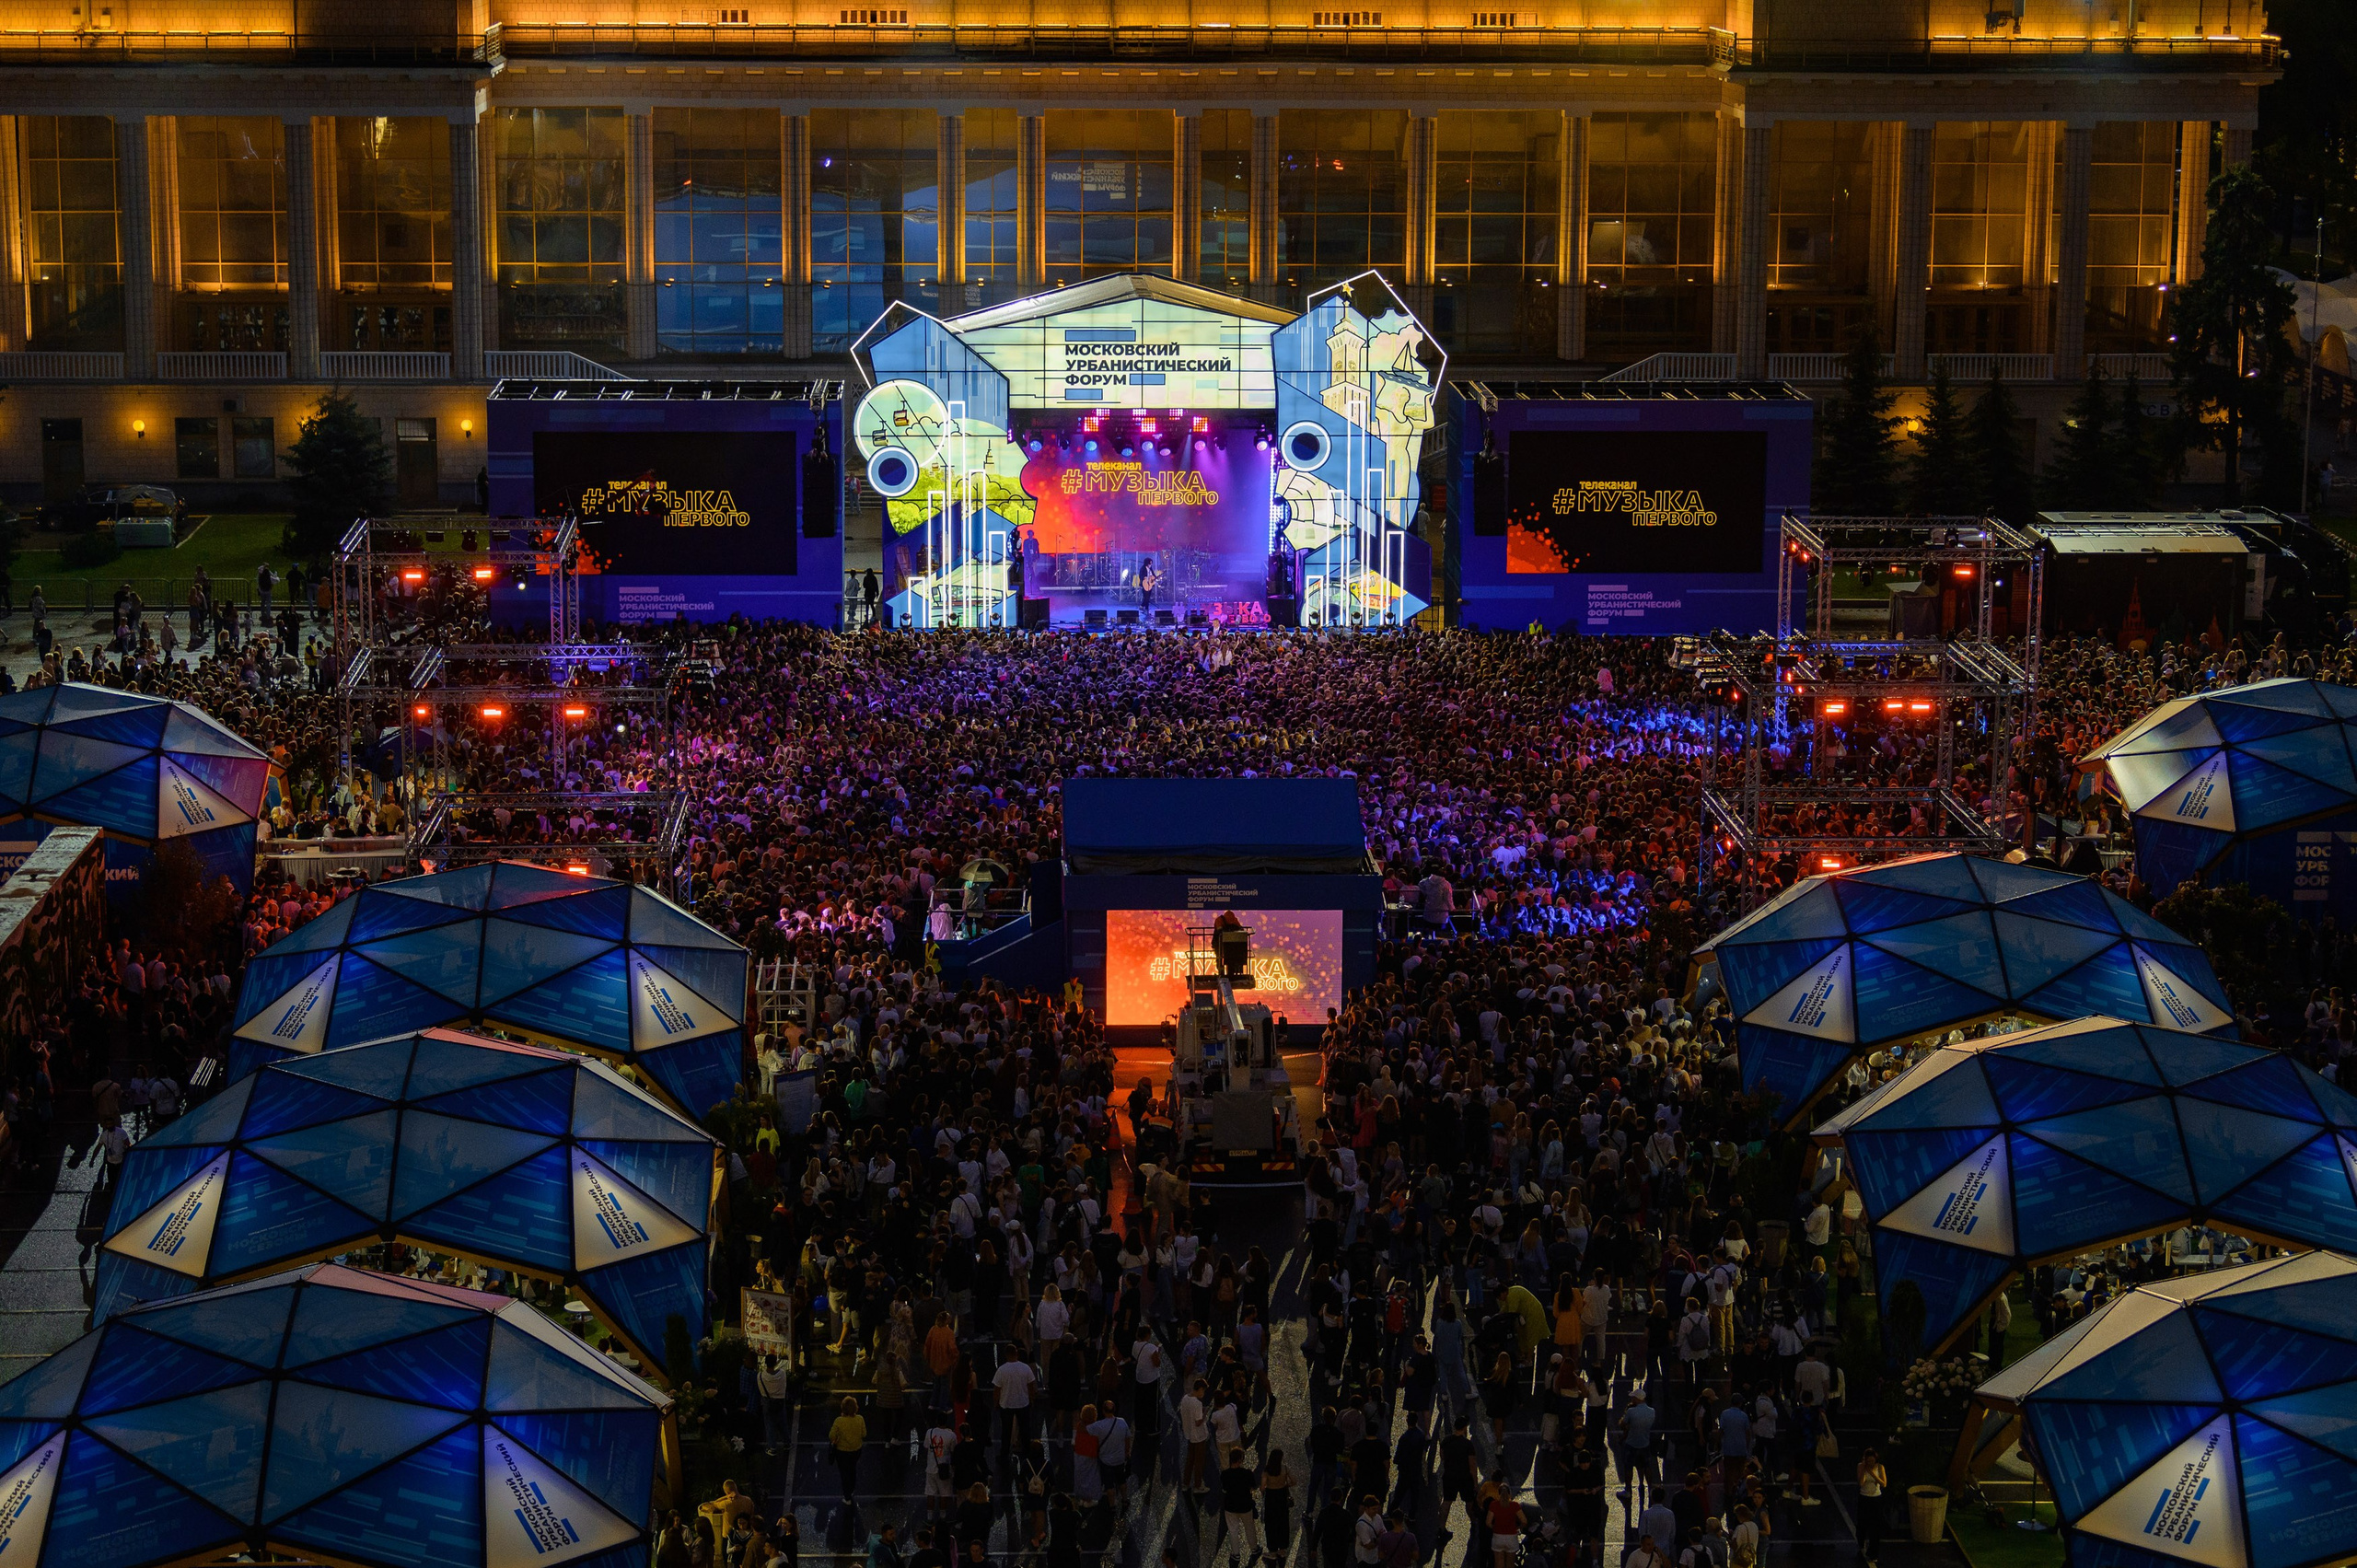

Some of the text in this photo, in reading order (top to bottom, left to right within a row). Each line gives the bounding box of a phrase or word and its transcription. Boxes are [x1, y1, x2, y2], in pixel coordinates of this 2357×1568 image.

[1065, 343, 1179, 356] МОСКОВСКИЙ
[1066, 357, 1231, 372] УРБАНИСТИЧЕСКИЙ
[1065, 374, 1127, 386] ФОРУМ
[1062, 469, 1206, 494] #МУЗЫКА
[1086, 462, 1142, 470] телеканал
[1138, 492, 1219, 505] ПЕРВОГО
[1552, 488, 1704, 515] #МУЗЫКА
[1579, 481, 1637, 491] телеканал
[1632, 511, 1717, 527] ПЕРВОГО
[619, 594, 685, 603] МОСКОВСКИЙ
[619, 611, 656, 620] ФОРУМ
[620, 602, 714, 611] УРБАНИСТИЧЕСКИЙ
[1587, 592, 1654, 600] МОСКОВСКИЙ
[1588, 600, 1682, 610] УРБАНИСТИЧЕСКИЙ
[168, 766, 205, 824] УРБАНИСТИЧЕСКИЙ
[173, 784, 200, 825] МОСКОВСКИЙ
[2182, 777, 2206, 817] МОСКОВСКИЙ
[2188, 761, 2220, 818] УРБАНИСТИЧЕСКИЙ
[2194, 797, 2208, 819] ФОРУМ
[195, 800, 210, 822] ФОРУМ
[282, 967, 332, 1038] УРБАНИСТИЧЕСКИЙ
[637, 962, 684, 1031] УРБАНИСТИЧЕСКИЙ
[644, 984, 679, 1033] МОСКОВСКИЙ
[1794, 975, 1825, 1024] МОСКОВСКИЙ
[1801, 956, 1843, 1025] УРБАНИСТИЧЕСКИЙ
[2140, 956, 2192, 1025] УРБАНИСТИЧЕСКИЙ
[2151, 978, 2189, 1027] МОСКОВСКИЙ
[277, 987, 313, 1037] МОСКОВСКИЙ
[287, 1012, 308, 1039] ФОРУМ
[670, 1004, 690, 1030] ФОРУМ
[1807, 1000, 1826, 1027] ФОРУМ
[2176, 998, 2197, 1024] ФОРУМ
[580, 1161, 634, 1245] УРБАНИСТИЧЕСКИЙ
[1940, 1171, 1976, 1230] МОСКОВСКИЙ
[1948, 1147, 1997, 1232] УРБАНИСТИЧЕСКИЙ
[153, 1191, 196, 1251] МОСКОВСКИЙ
[158, 1167, 219, 1253] УРБАНИСТИЧЕСКИЙ
[588, 1189, 629, 1248] МОСКОВСКИЙ
[620, 1212, 642, 1243] ФОРУМ
[1956, 1202, 1978, 1234] ФОРУМ
[165, 1222, 189, 1254] ФОРУМ
[0, 1449, 53, 1529] НИСТИЧЕСКИЙ
[0, 1480, 26, 1516] ВСКИЙ
[495, 1443, 563, 1549] УРБАНИСТИЧЕСКИЙ
[2154, 1463, 2195, 1537] МОСКОВСКИЙ
[2164, 1434, 2221, 1539] УРБАНИСТИЧЕСКИЙ
[505, 1478, 554, 1551] МОСКОВСКИЙ
[543, 1506, 570, 1545] ФОРУМ
[2174, 1502, 2199, 1541] ФОРУМ
